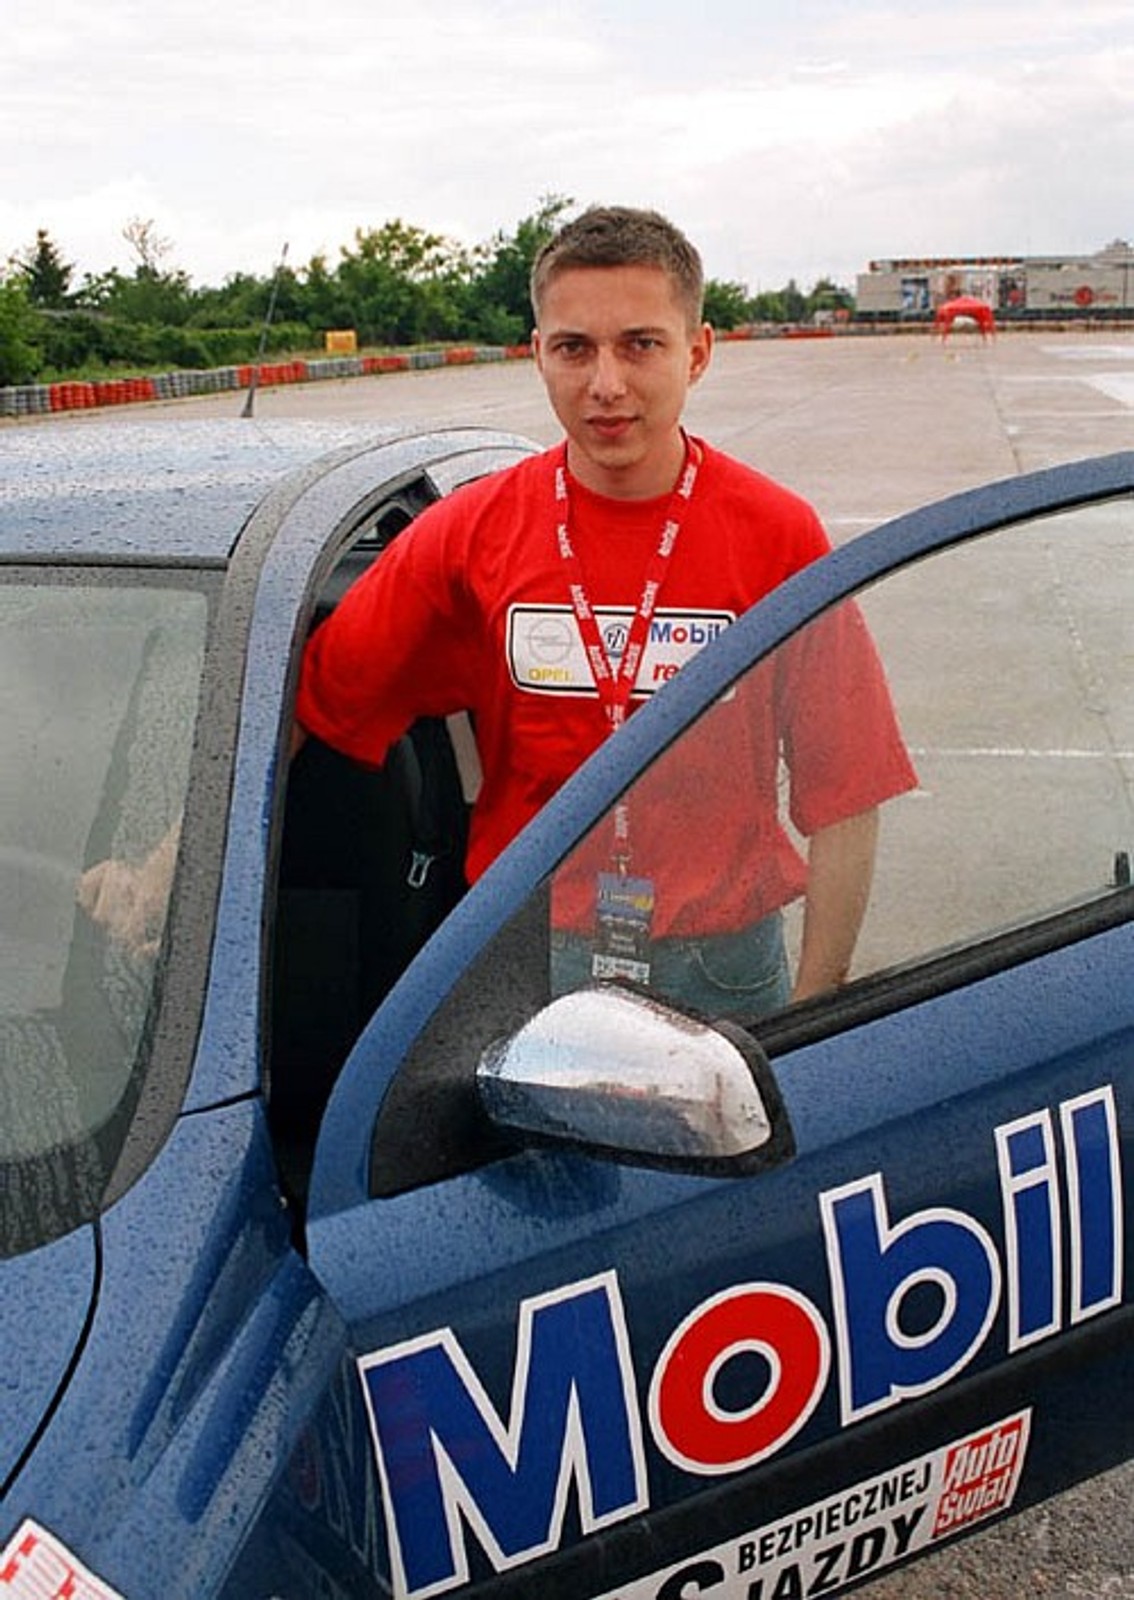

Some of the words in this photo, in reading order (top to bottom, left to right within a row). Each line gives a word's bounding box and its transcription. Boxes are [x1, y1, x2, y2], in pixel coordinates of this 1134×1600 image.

[651, 622, 721, 643] Mobil
[528, 668, 573, 682] OPEL
[356, 1084, 1124, 1600] Mobil
[945, 1429, 1018, 1490] Auto
[737, 1462, 932, 1574] BEZPIECZNEJ
